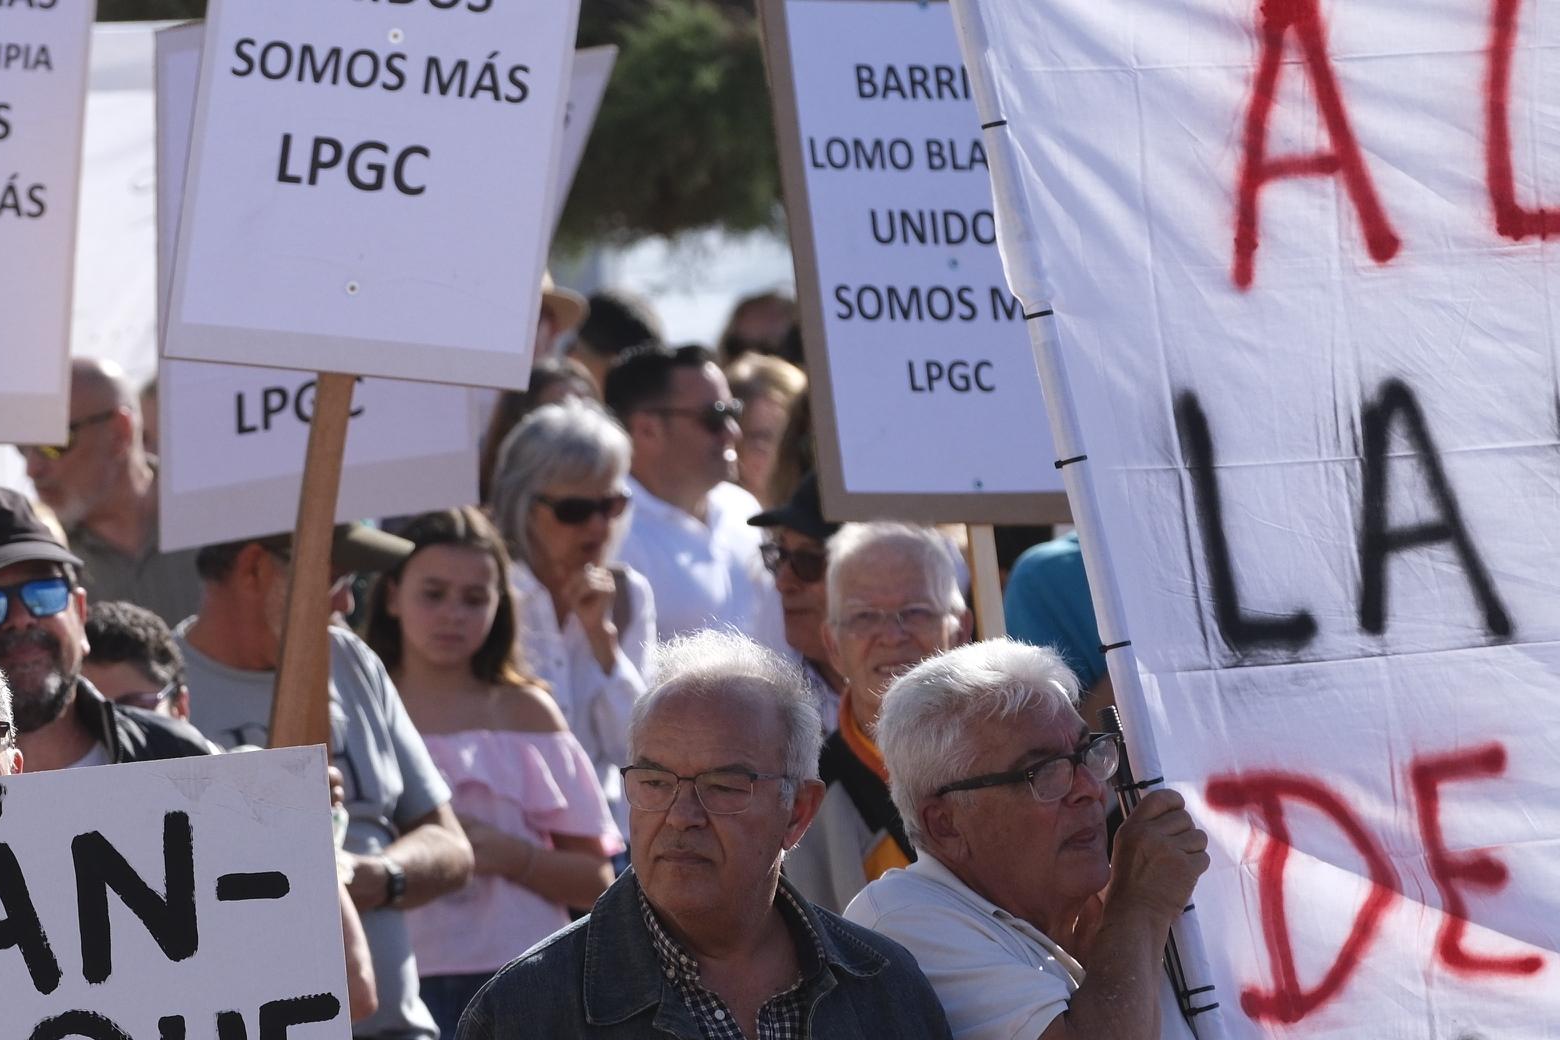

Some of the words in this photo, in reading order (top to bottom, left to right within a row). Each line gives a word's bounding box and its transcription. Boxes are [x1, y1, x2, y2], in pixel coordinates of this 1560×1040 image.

[231, 38, 408, 91] SOMOS
[423, 51, 530, 103] MÁS
[855, 64, 971, 100] BARRI
[277, 133, 430, 195] LPGC
[809, 137, 914, 170] LOMO
[926, 138, 989, 172] BLA
[870, 209, 996, 246] UNIDO
[834, 285, 978, 321] SOMOS
[908, 360, 996, 392] LPGC
